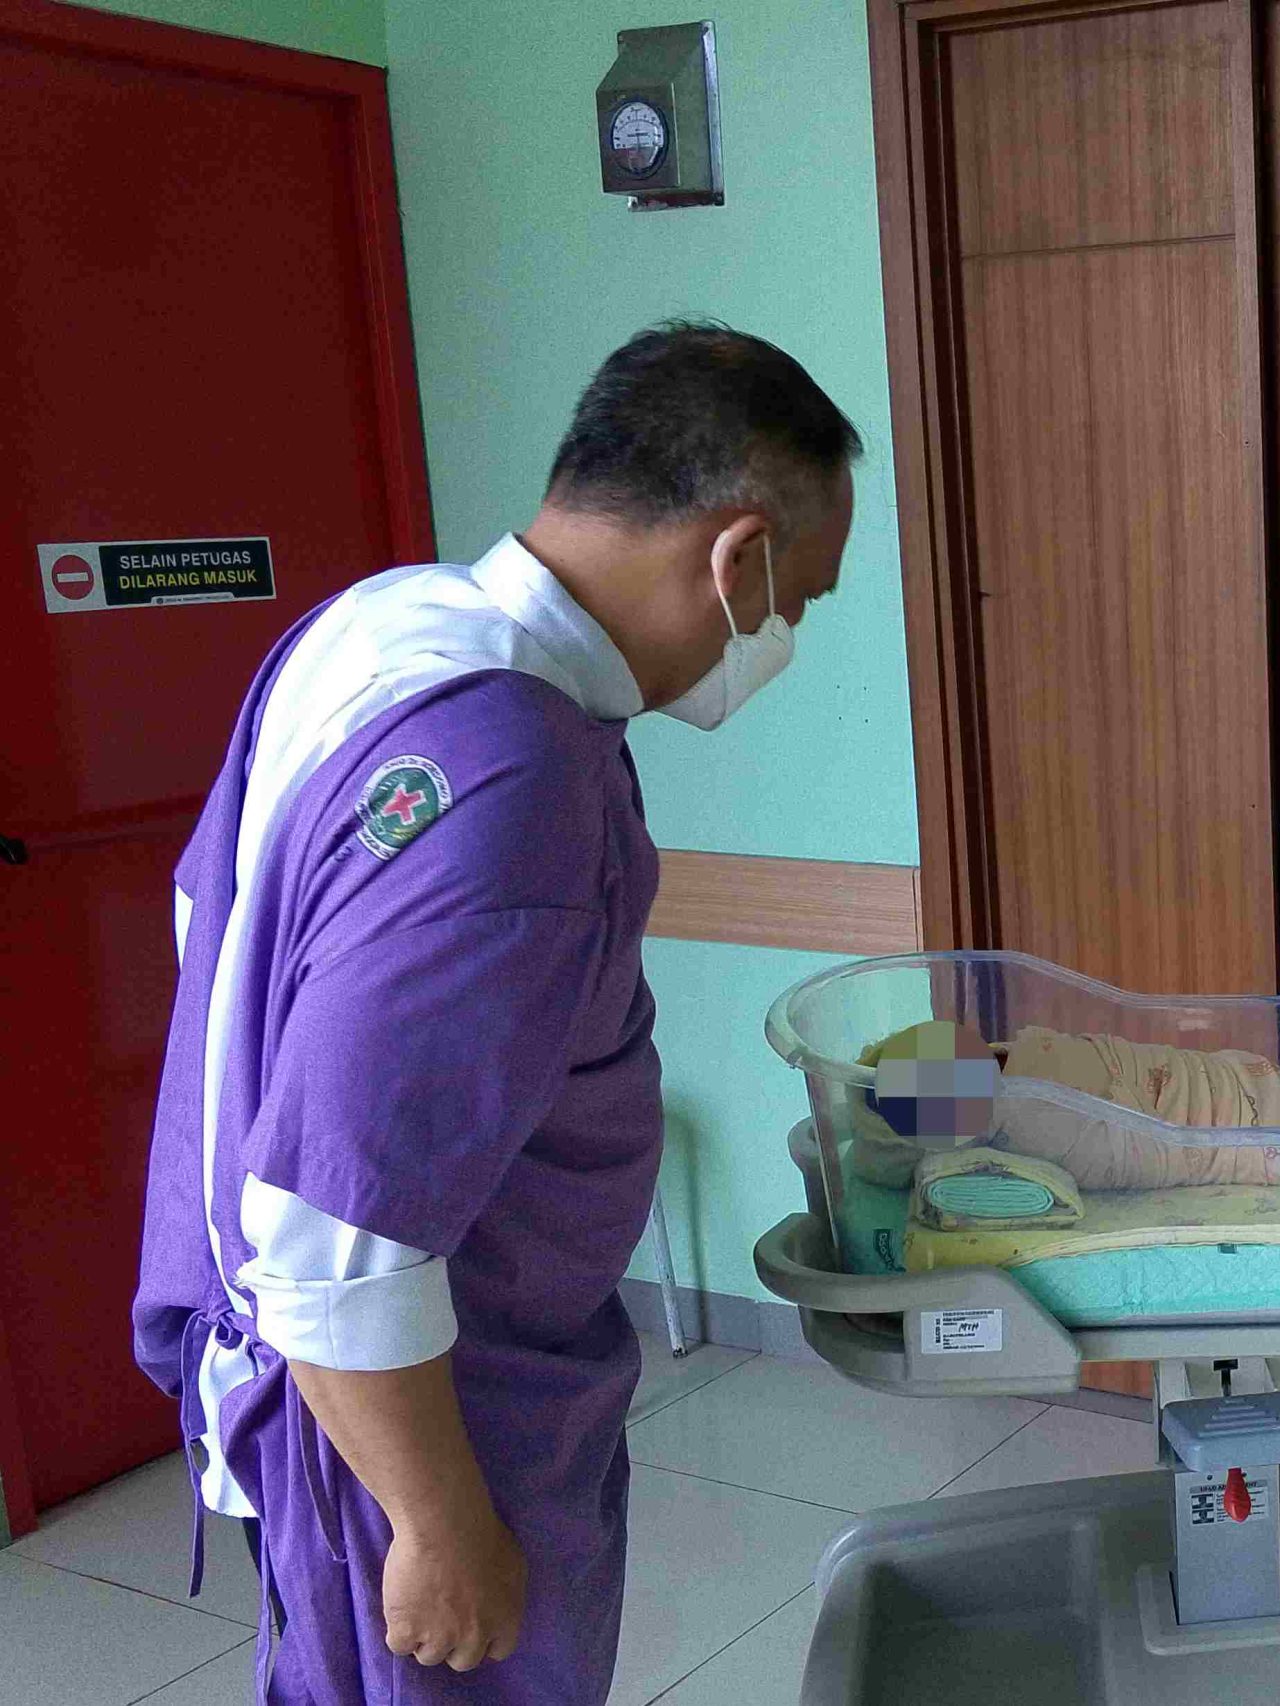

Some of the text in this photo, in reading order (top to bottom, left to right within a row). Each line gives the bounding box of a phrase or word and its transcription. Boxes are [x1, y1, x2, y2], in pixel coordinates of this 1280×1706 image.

[120, 551, 251, 570] SELAIN PETUGAS
[119, 569, 257, 589] DILARANG MASUK
